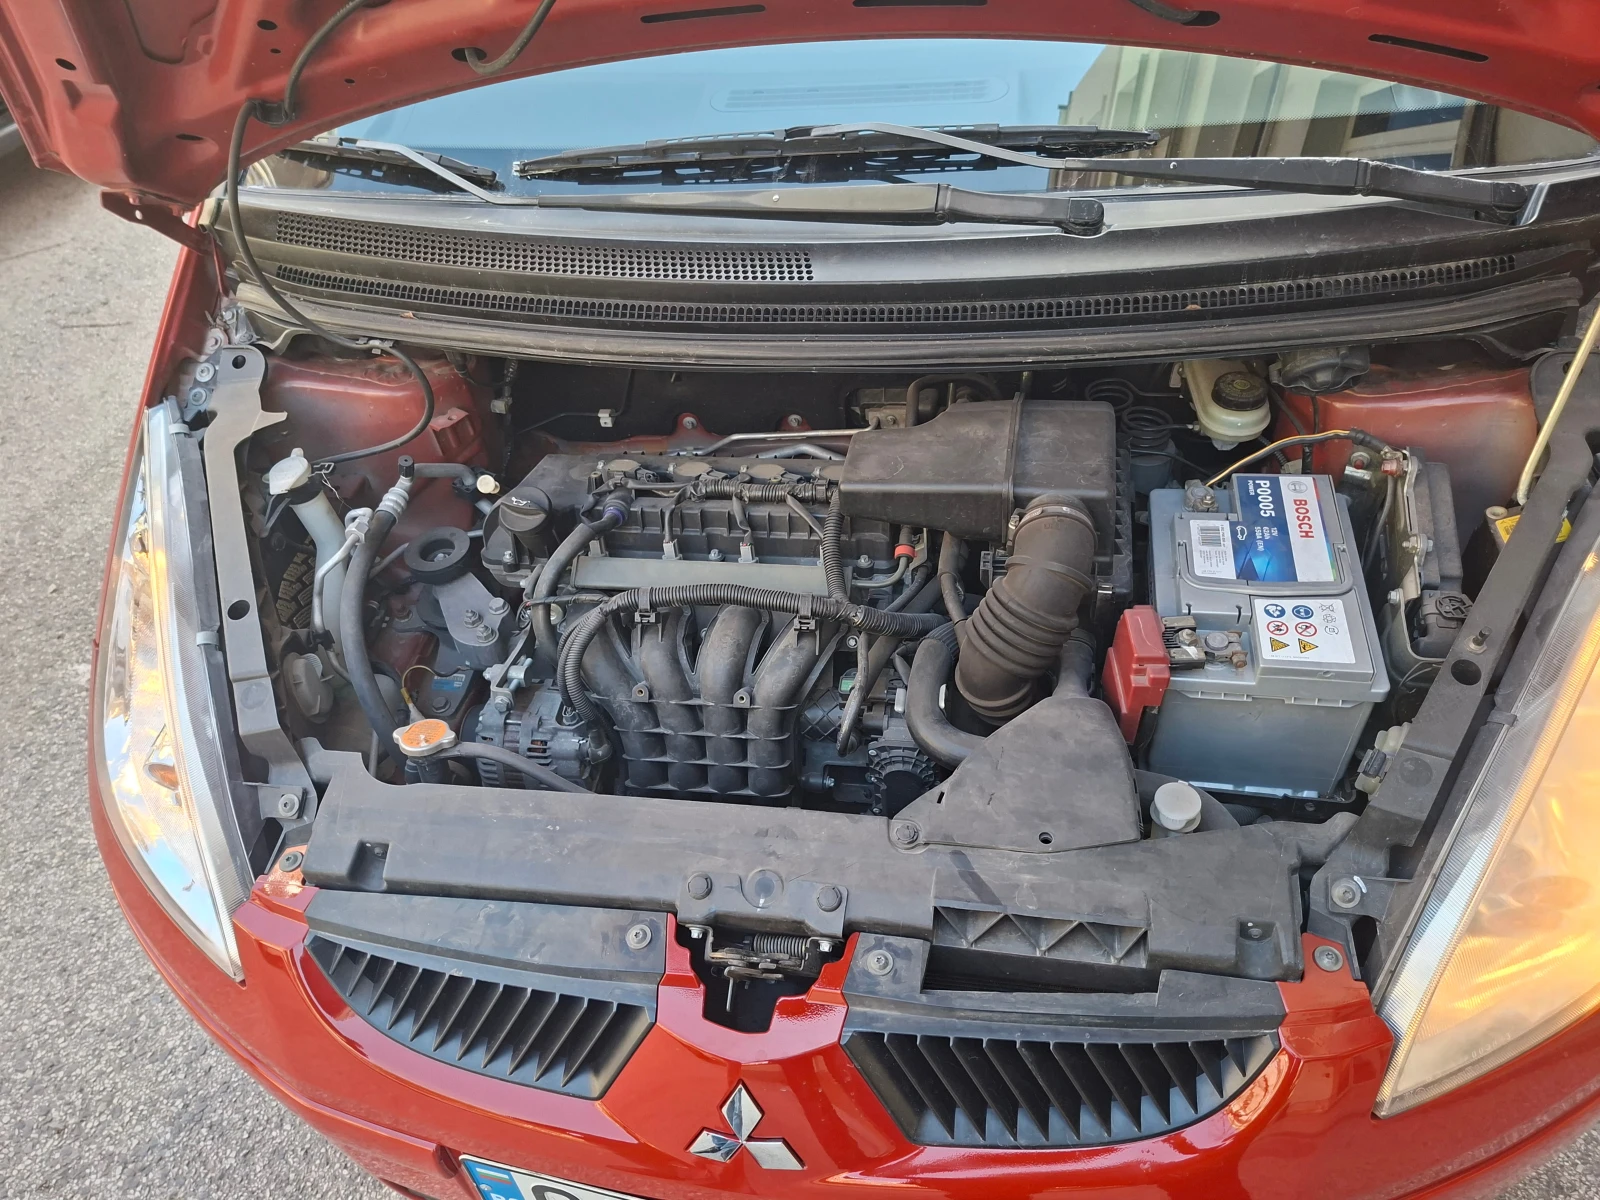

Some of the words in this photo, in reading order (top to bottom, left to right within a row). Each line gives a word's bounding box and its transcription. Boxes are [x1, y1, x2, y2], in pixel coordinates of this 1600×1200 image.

[1247, 480, 1255, 496] POWER
[1255, 480, 1276, 517] P0005
[1293, 498, 1315, 539] BOSCH
[1271, 527, 1279, 537] 12V
[1256, 540, 1265, 552] (EN)
